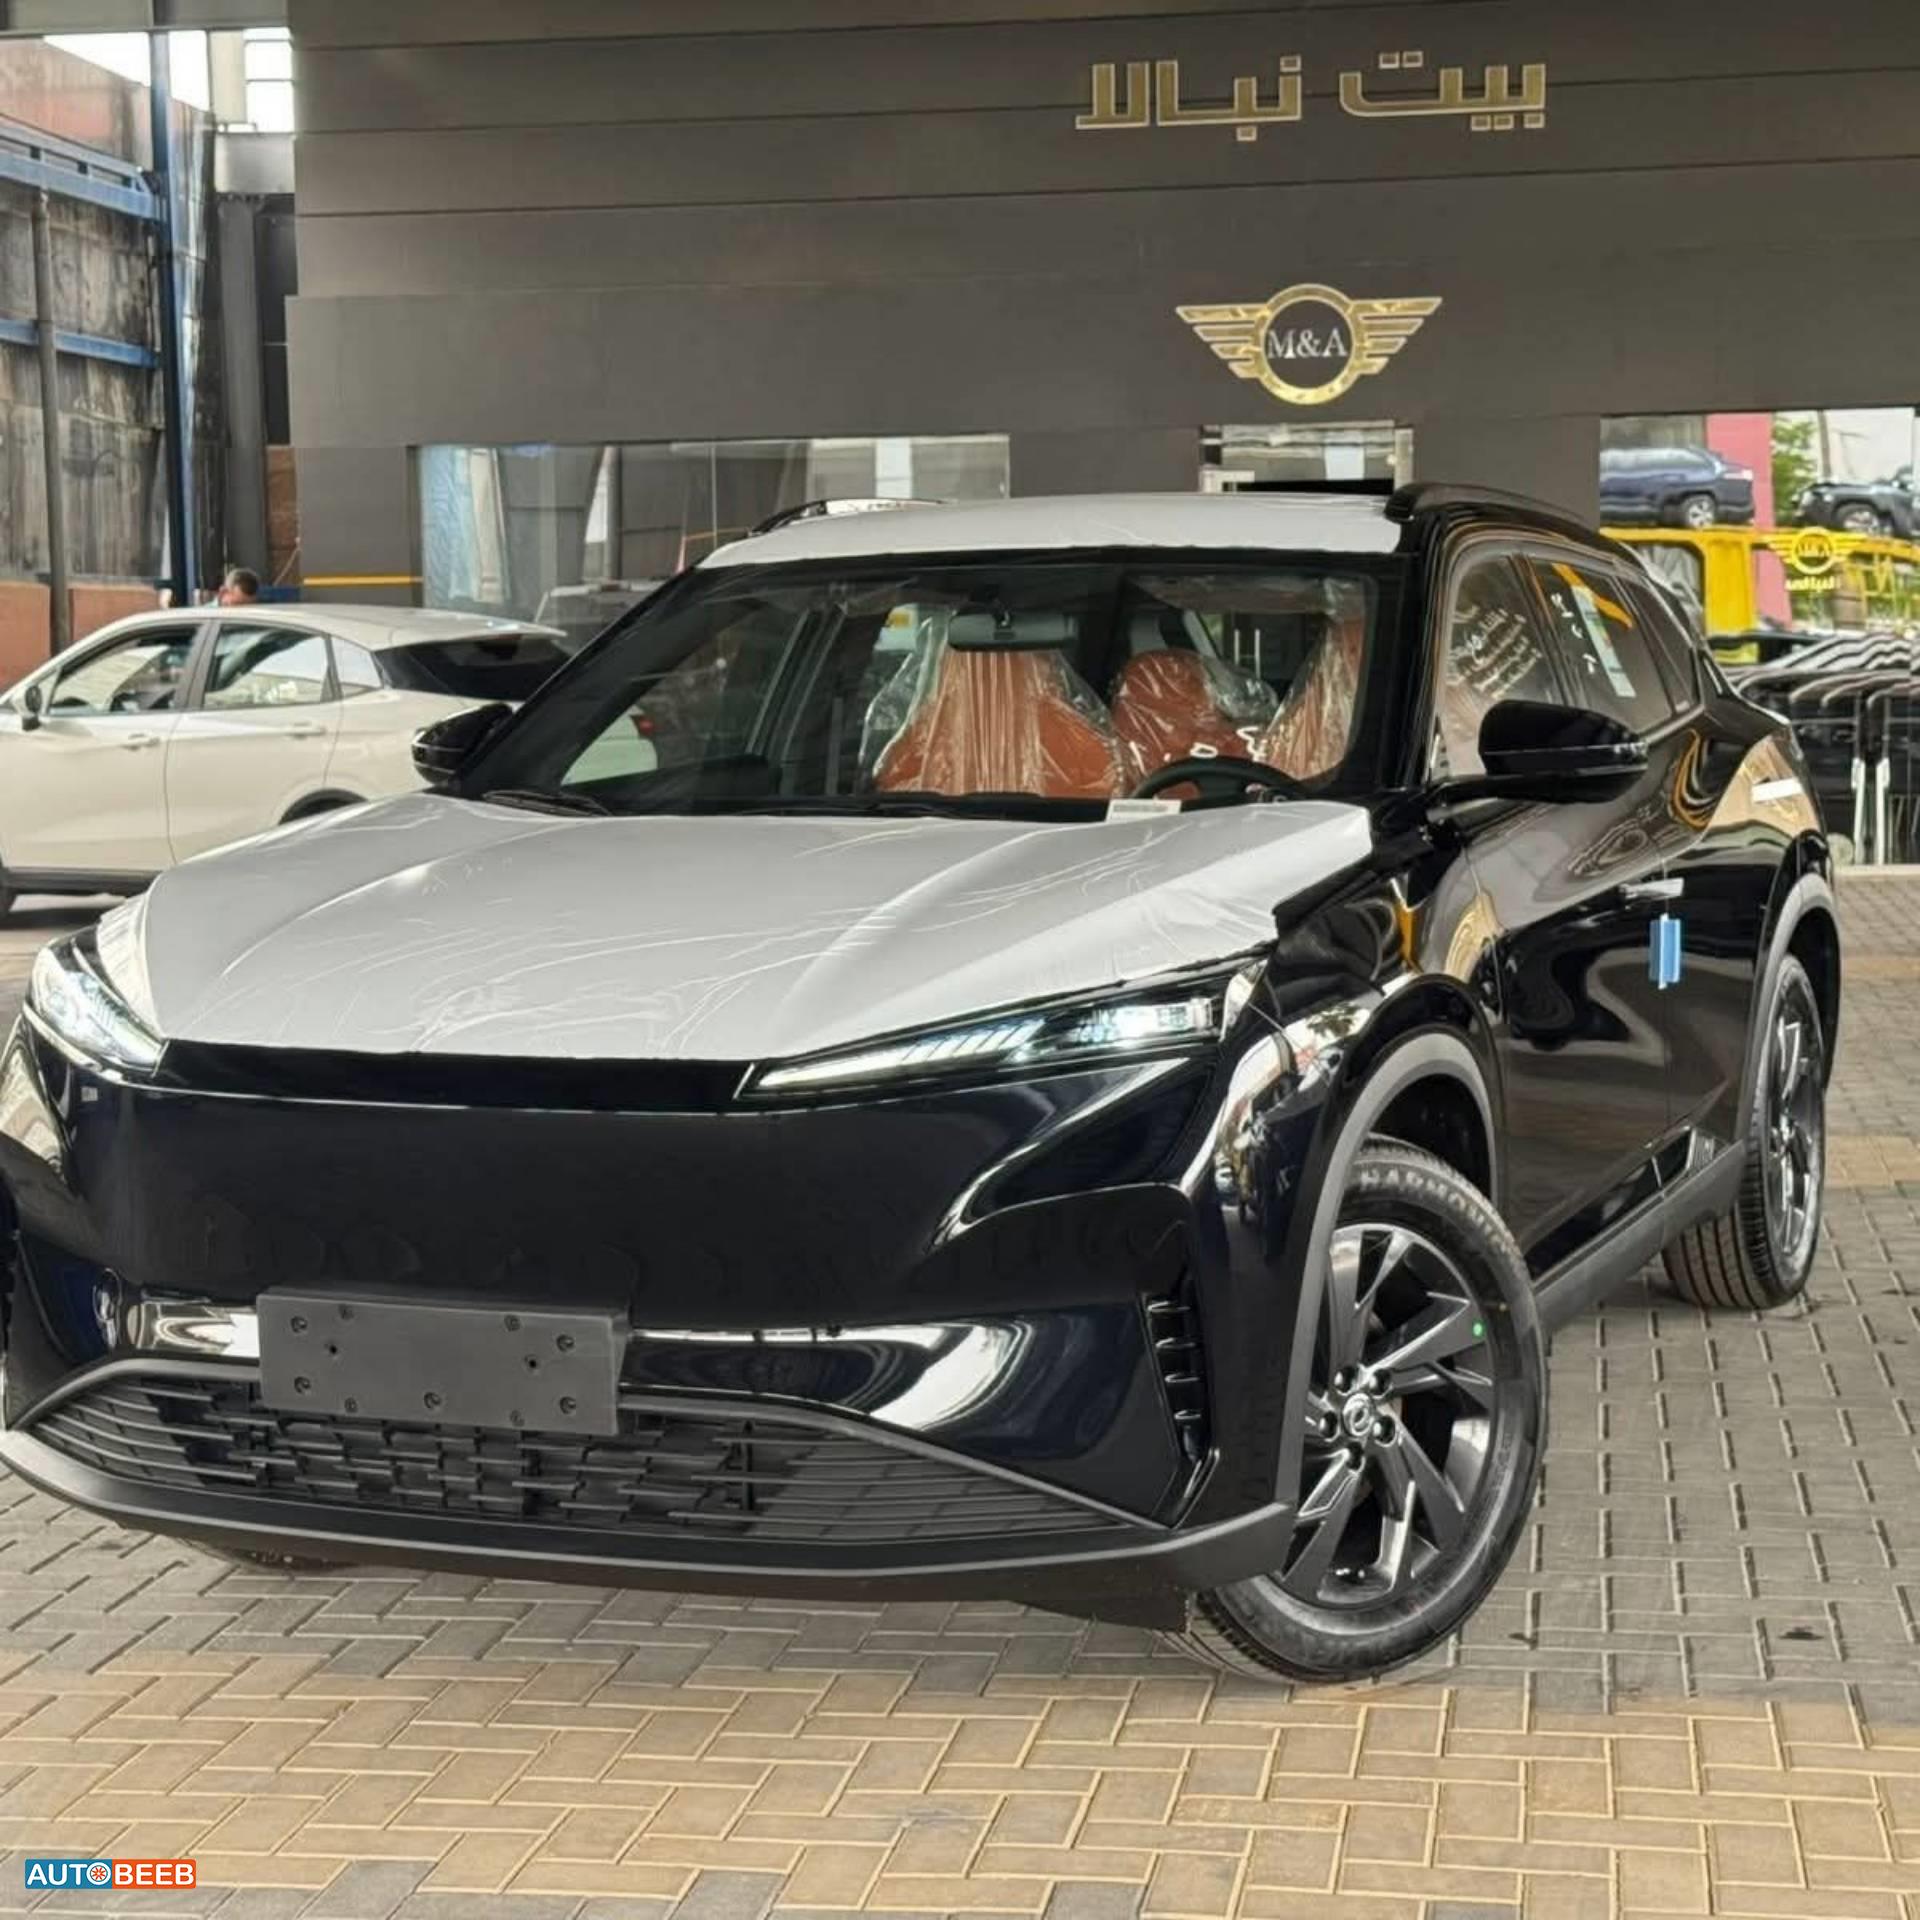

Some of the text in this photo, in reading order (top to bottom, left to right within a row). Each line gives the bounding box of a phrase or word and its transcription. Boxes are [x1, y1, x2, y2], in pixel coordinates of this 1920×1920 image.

[1075, 51, 1546, 141] بيت نبالا
[1267, 328, 1347, 359] M&A
